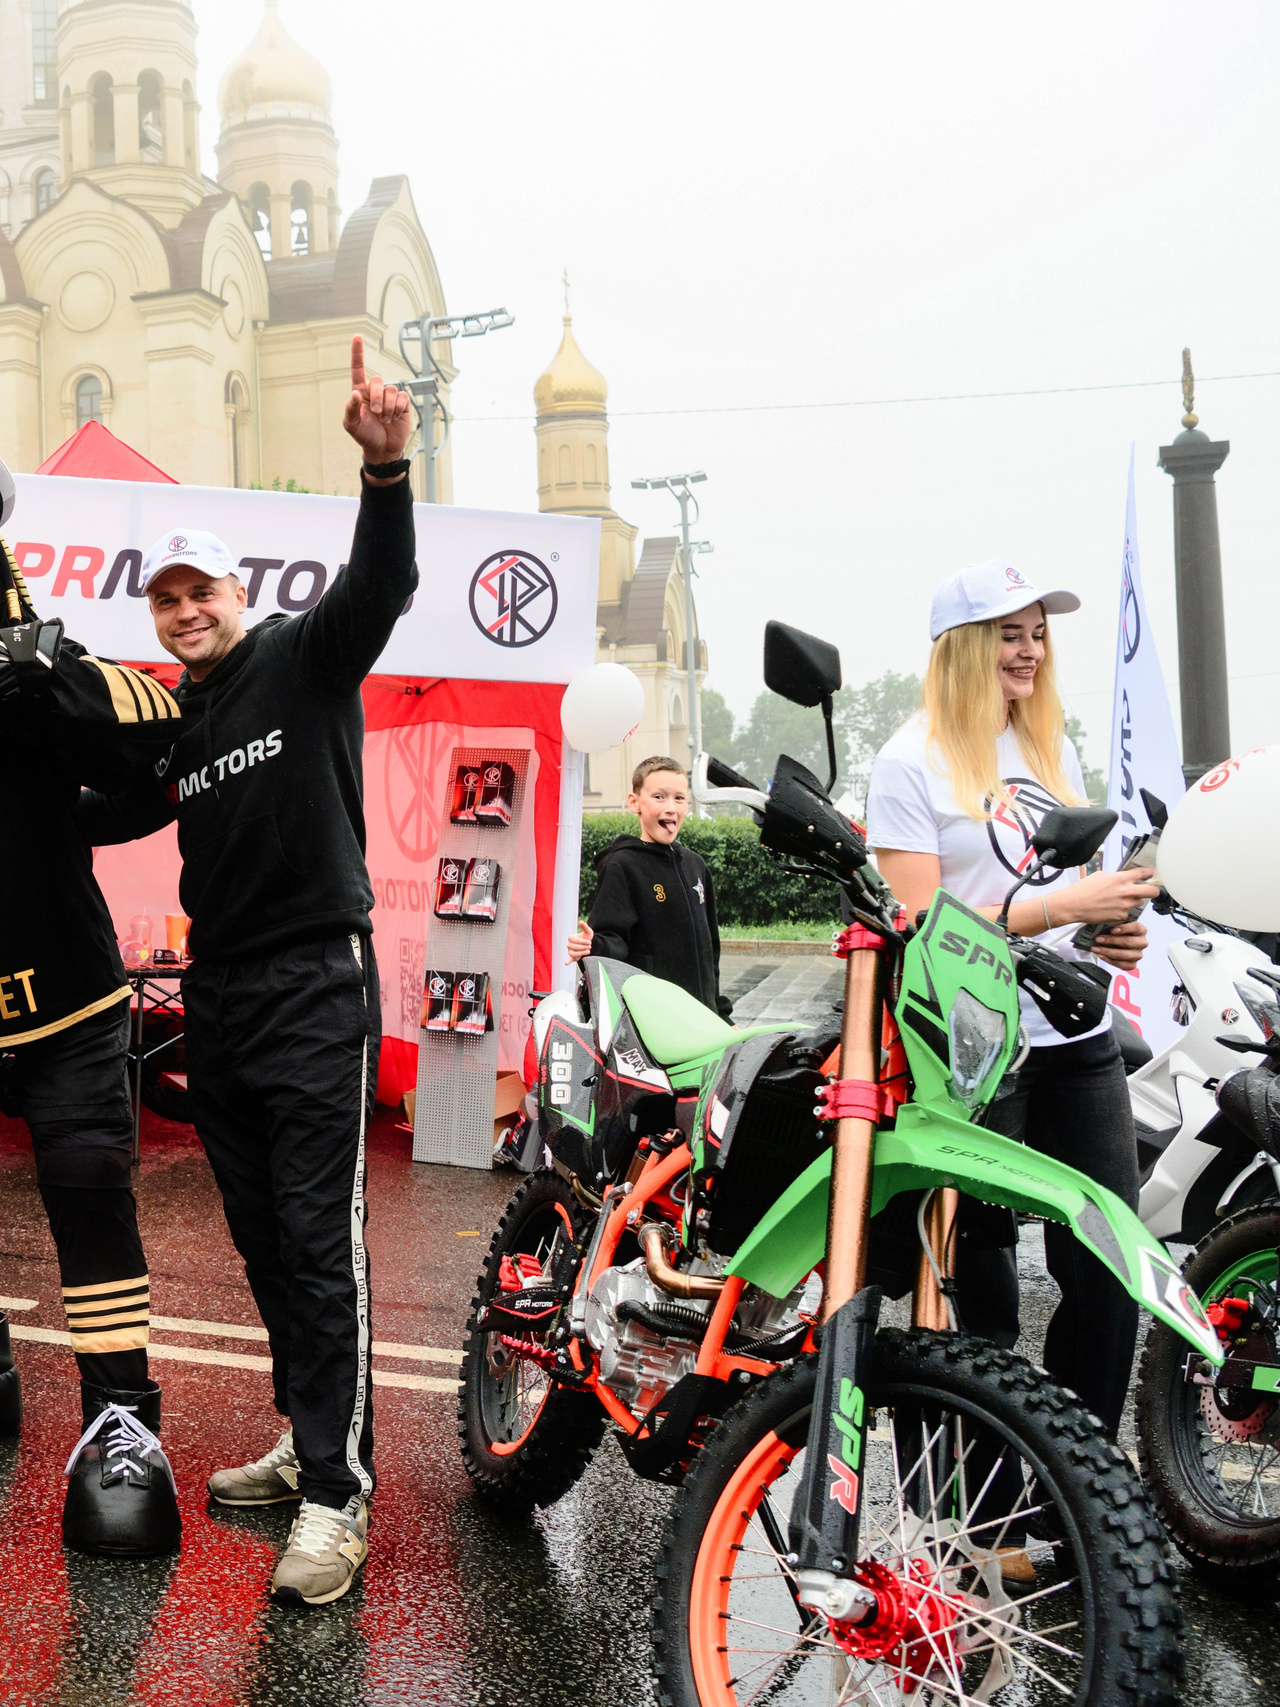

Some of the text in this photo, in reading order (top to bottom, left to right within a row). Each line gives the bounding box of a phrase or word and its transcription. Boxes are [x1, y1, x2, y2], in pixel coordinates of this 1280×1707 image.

[653, 883, 667, 903] 3
[938, 930, 1013, 990] SPR
[550, 1041, 573, 1105] 300
[620, 1048, 648, 1076] MAX
[935, 1145, 1065, 1192] SPR MOTORS
[353, 1240, 367, 1311] JUST DO IT
[353, 1347, 367, 1418] JUST DO IT
[347, 1454, 370, 1483] JUST
[826, 1376, 865, 1515] SPR
